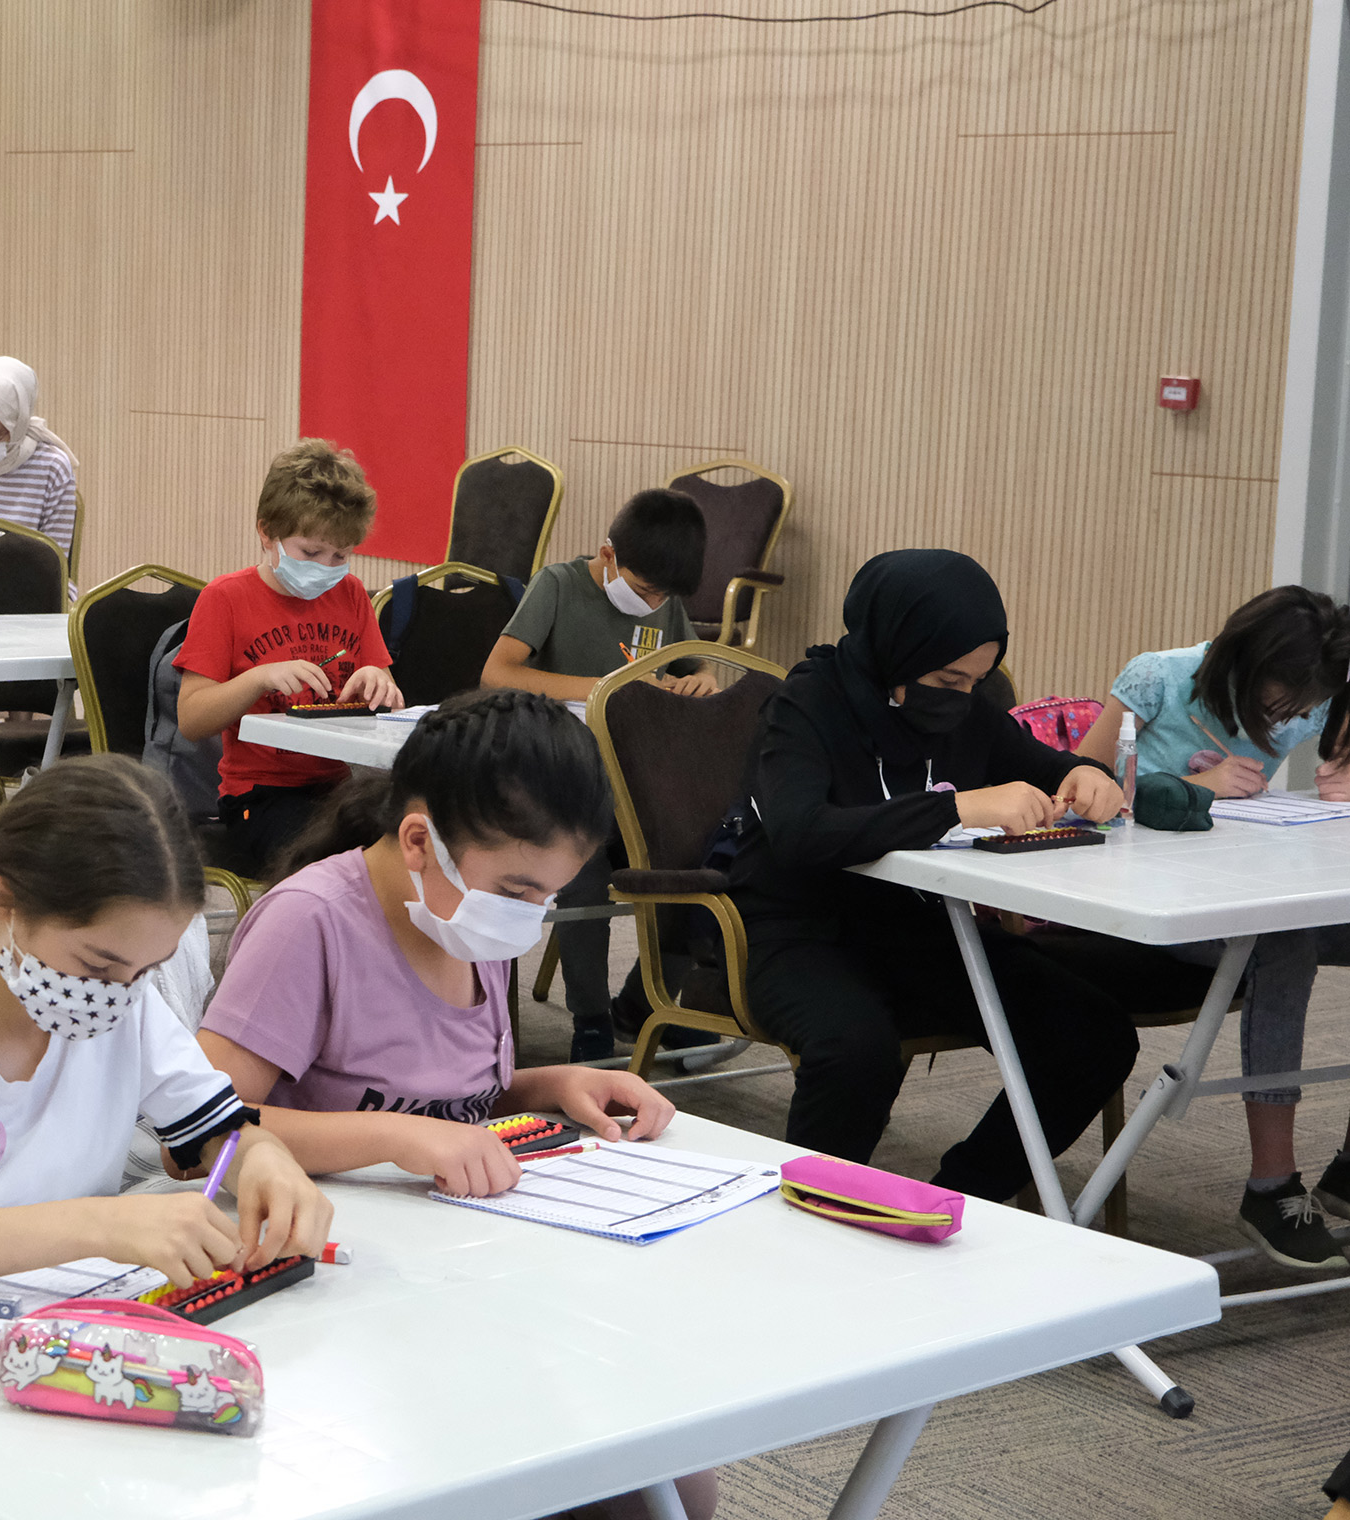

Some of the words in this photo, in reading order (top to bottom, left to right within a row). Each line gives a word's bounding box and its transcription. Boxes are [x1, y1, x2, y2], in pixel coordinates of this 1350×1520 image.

[243, 624, 293, 666] MOTOR
[297, 622, 361, 657] COMPANY
[310, 643, 329, 655] RACE
